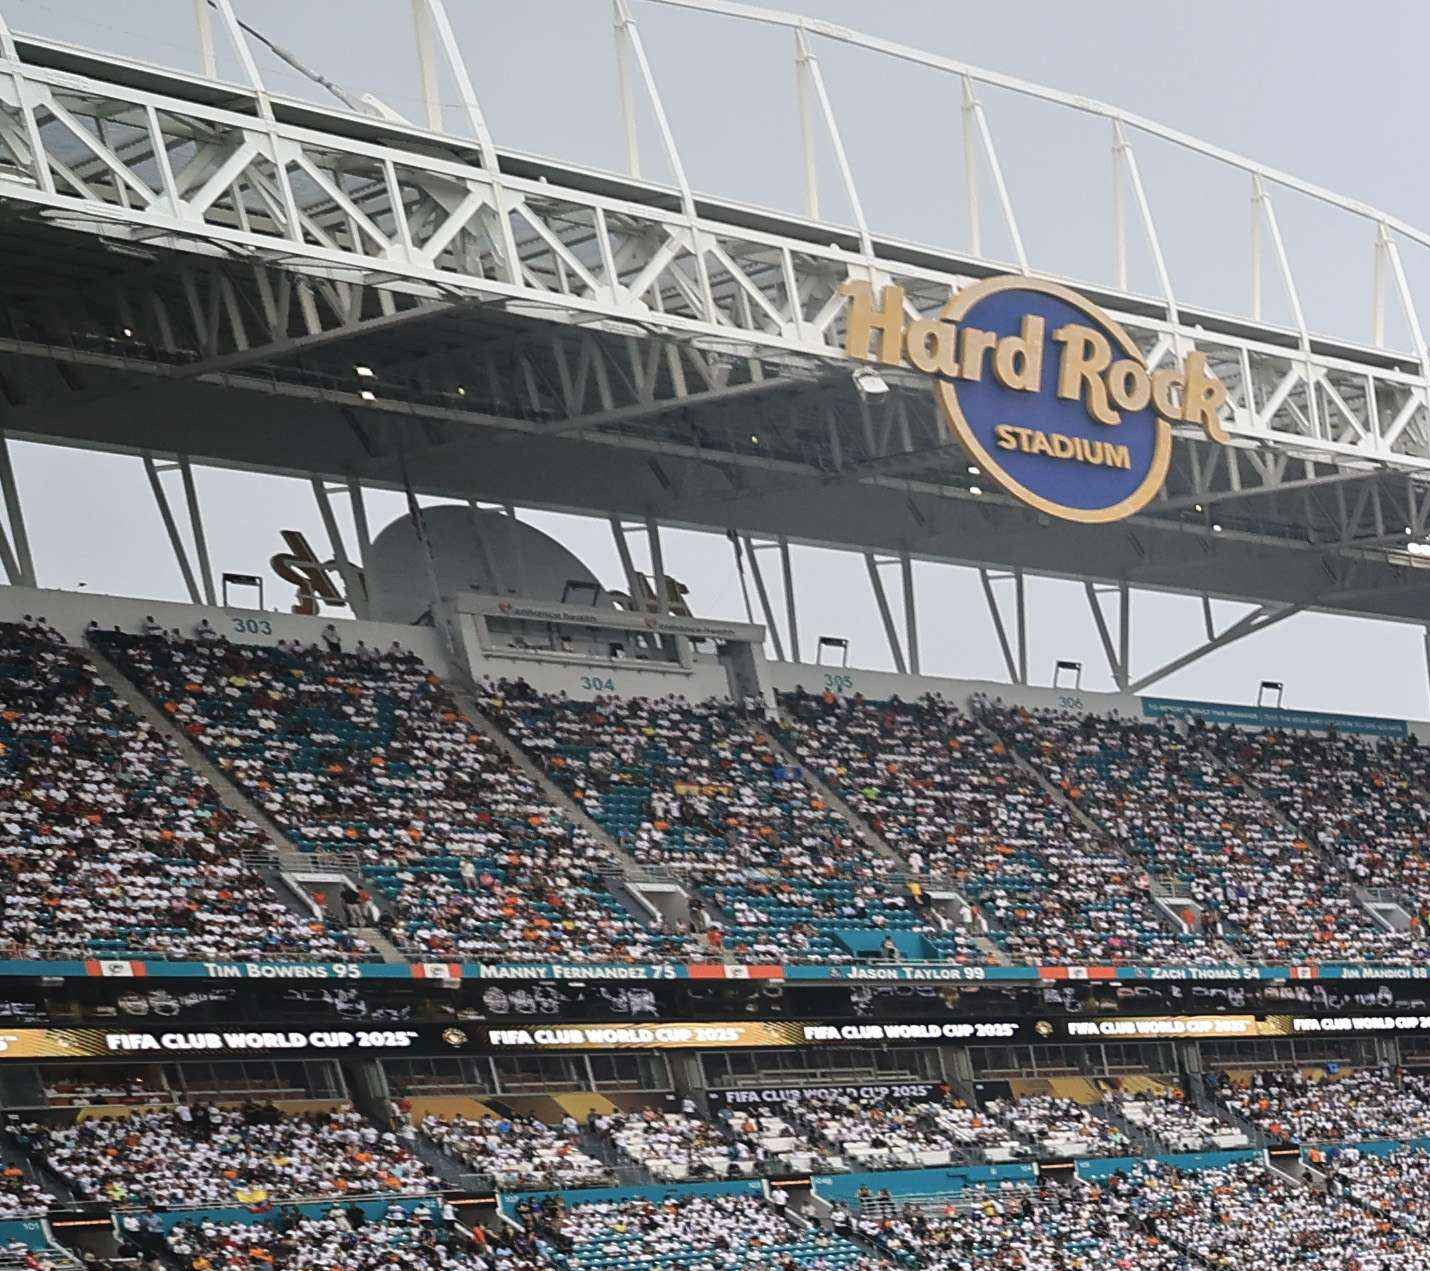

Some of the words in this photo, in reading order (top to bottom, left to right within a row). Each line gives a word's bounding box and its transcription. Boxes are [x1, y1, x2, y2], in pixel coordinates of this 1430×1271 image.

[837, 280, 1046, 393] Hard
[1052, 322, 1231, 446] Rock
[994, 424, 1132, 470] STADIUM
[232, 618, 272, 635] 303
[581, 676, 614, 691] 304
[331, 964, 362, 979] 95
[652, 964, 676, 979] 75
[964, 967, 986, 980] 99
[1243, 967, 1260, 979] 54
[105, 1034, 161, 1050] FIFA
[160, 1034, 222, 1049] CLUB
[222, 1032, 308, 1049] WORLD
[310, 1032, 355, 1049] CUP
